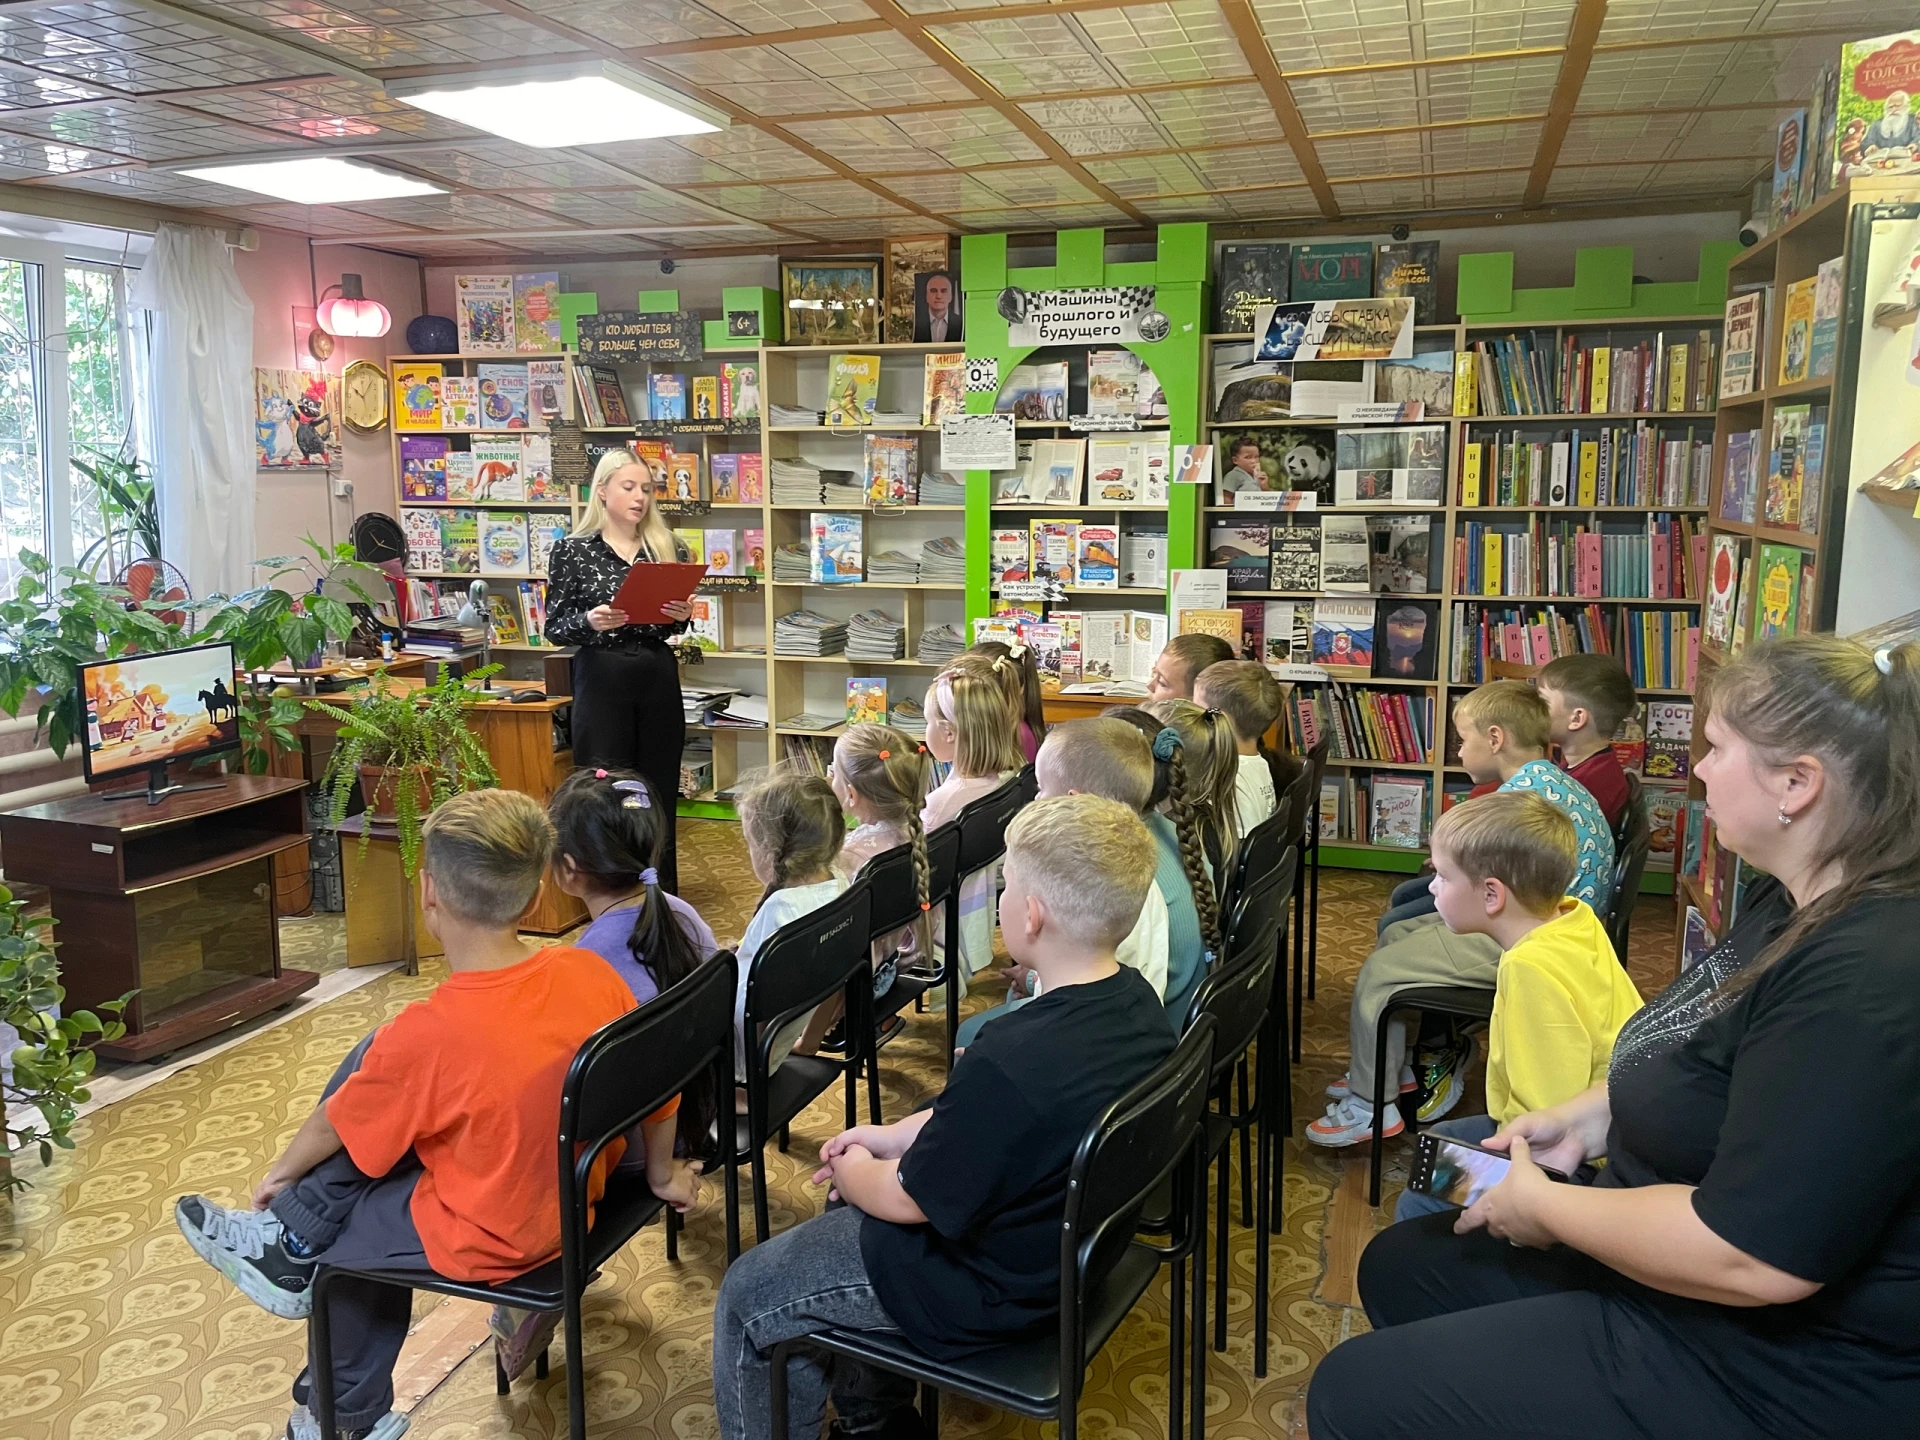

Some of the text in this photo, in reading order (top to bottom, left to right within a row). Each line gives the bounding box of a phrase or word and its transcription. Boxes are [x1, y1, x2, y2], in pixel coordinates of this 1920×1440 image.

[1044, 293, 1117, 307] Машины
[736, 316, 751, 330] 6+
[1031, 310, 1131, 328] прошлого и
[605, 323, 672, 336] КТО ЛЮБИТ ТЕБЯ
[1039, 325, 1121, 341] будущего
[598, 338, 681, 352] БОЛЬШЕ, ЧЕМ СЕБЯ
[970, 368, 995, 382] 0+
[496, 378, 524, 387] ГЕНОВ
[445, 385, 475, 394] НОВАЯ
[409, 409, 433, 419] МИР
[678, 424, 702, 433] СОБАКАХ
[702, 424, 725, 432] НАУЧНО
[638, 445, 663, 453] СОБАКИ
[475, 452, 520, 461] ЖИВОТНЫЕ
[1599, 433, 1609, 501] РУССКИЕ СКАЗКИ
[833, 525, 852, 533] ЛЕС
[418, 530, 435, 539] ВСЁ
[1188, 618, 1235, 628] ИСТОРИЯ
